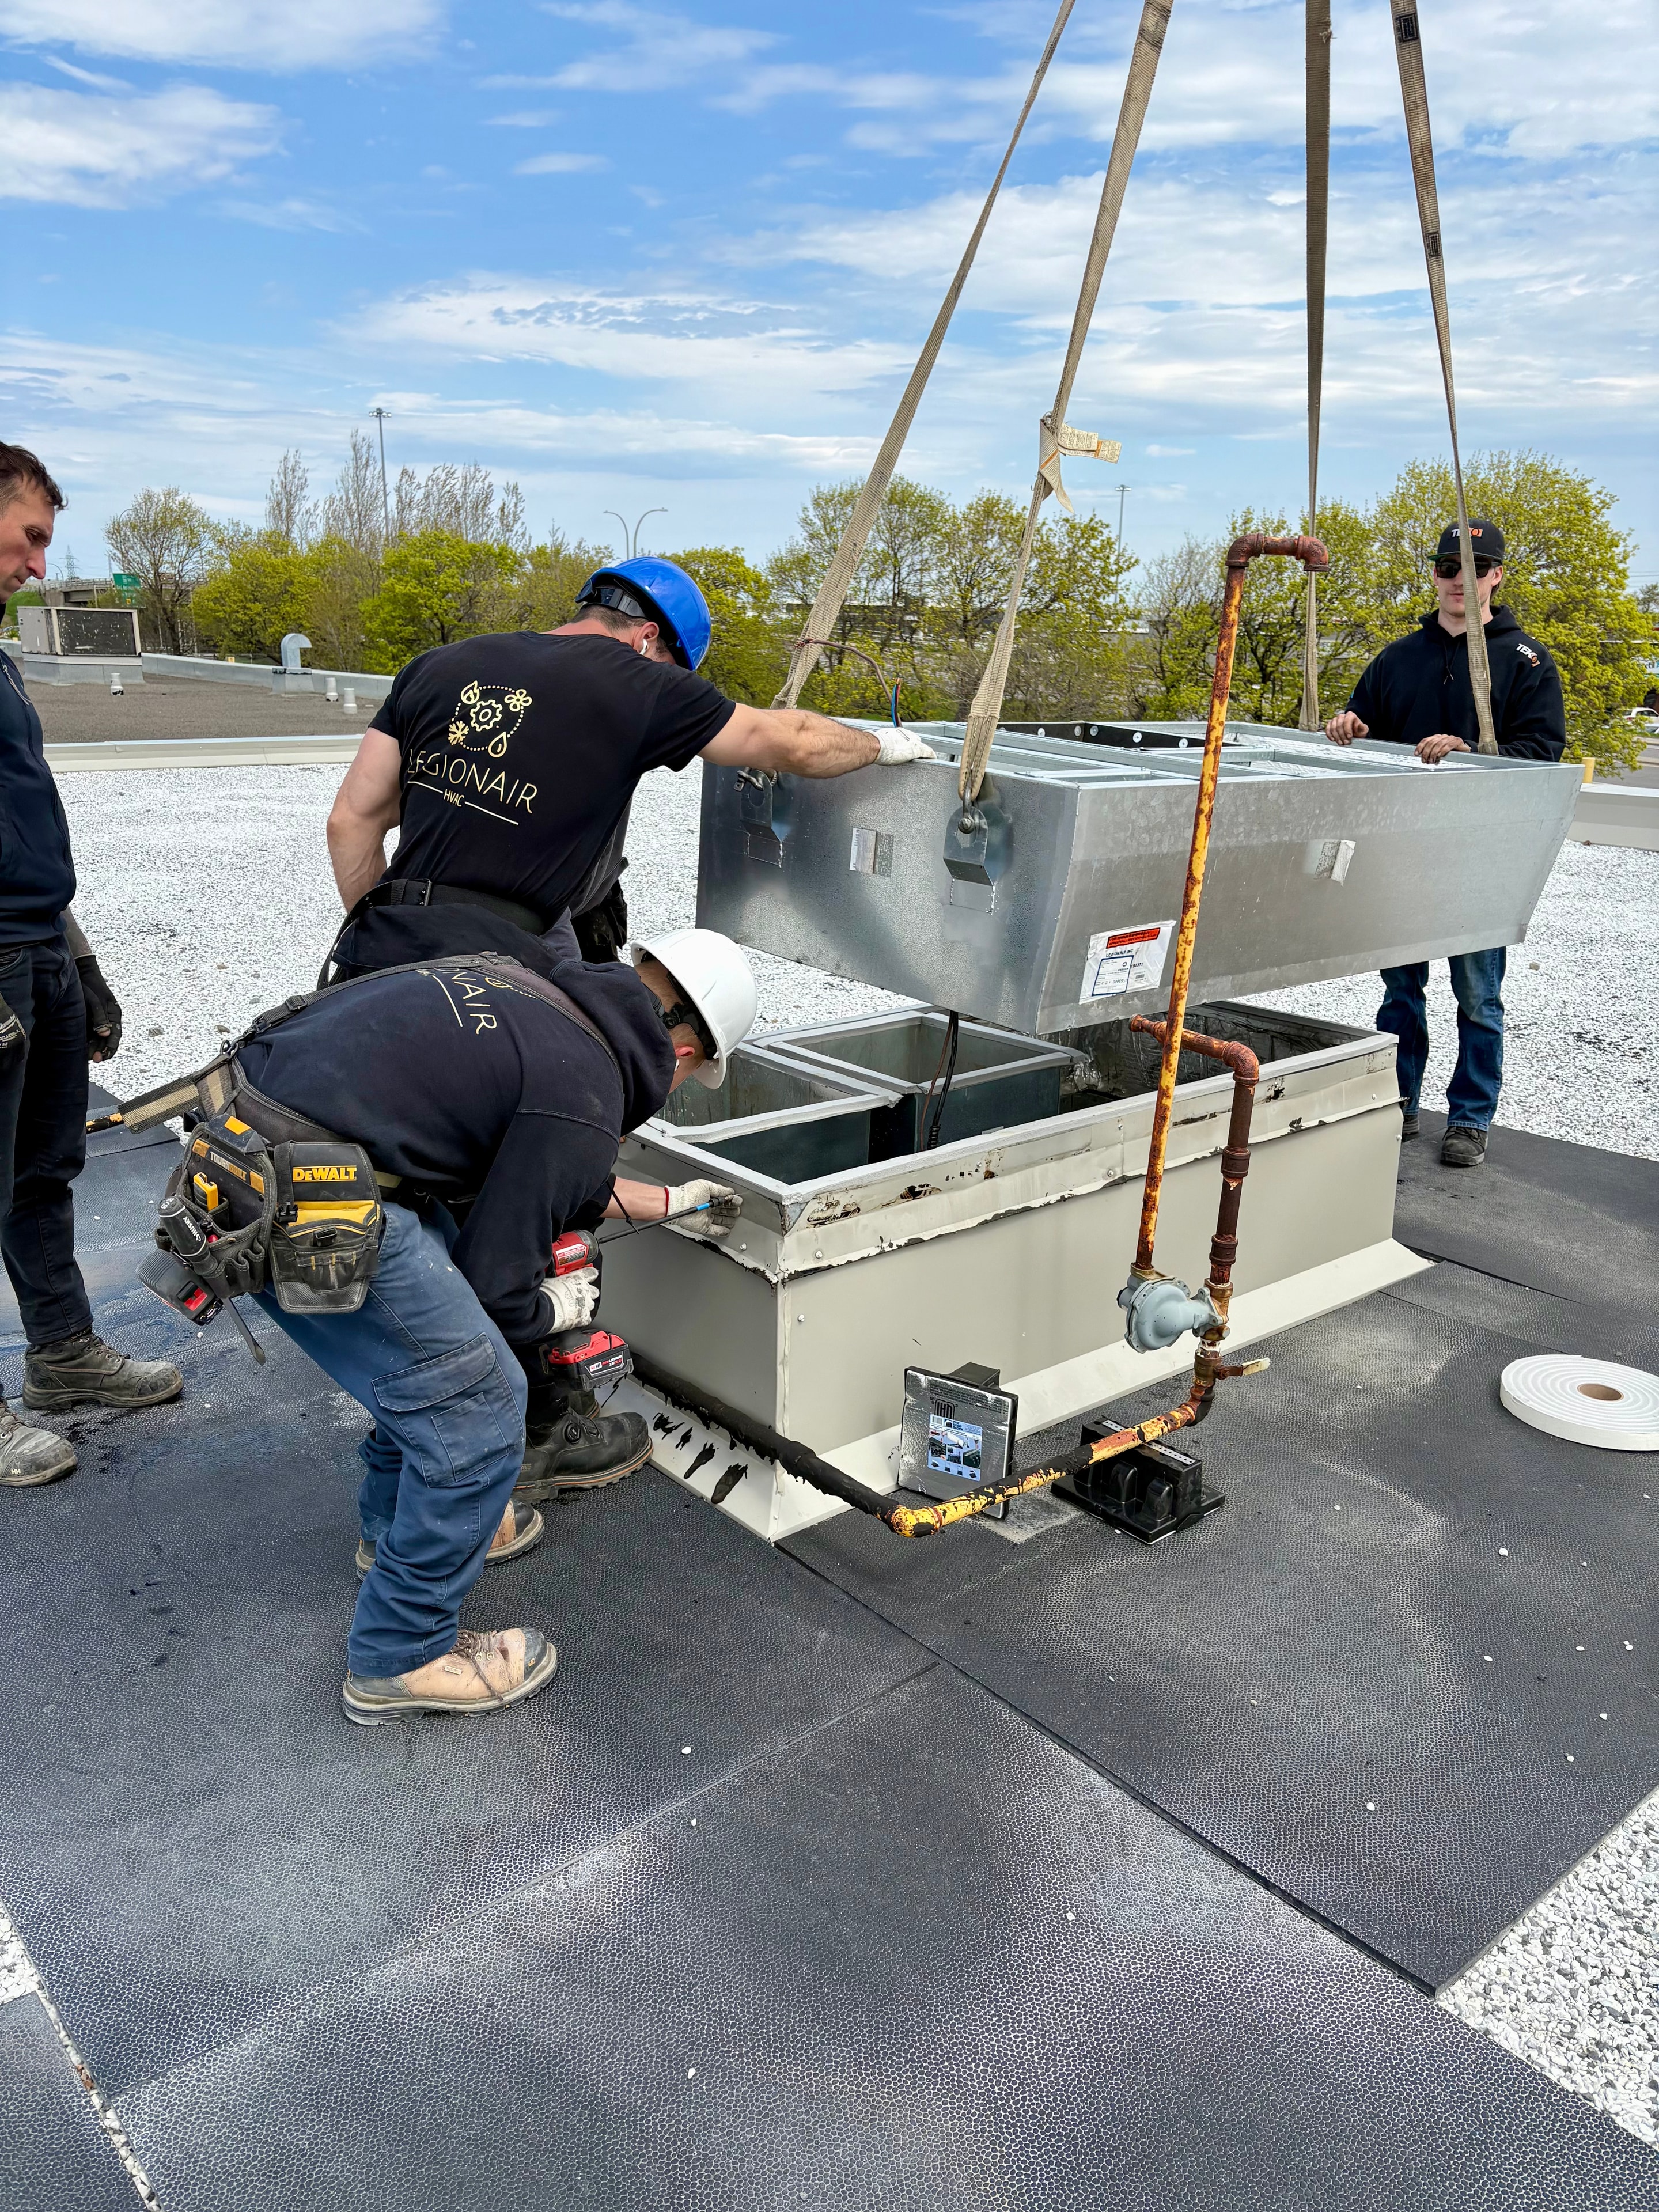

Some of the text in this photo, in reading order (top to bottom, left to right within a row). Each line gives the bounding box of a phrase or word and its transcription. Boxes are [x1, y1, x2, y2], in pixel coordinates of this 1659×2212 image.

[407, 749, 538, 813] LEGIONAIR
[444, 789, 465, 807] HVAC
[183, 1216, 198, 1237] HUSKY
